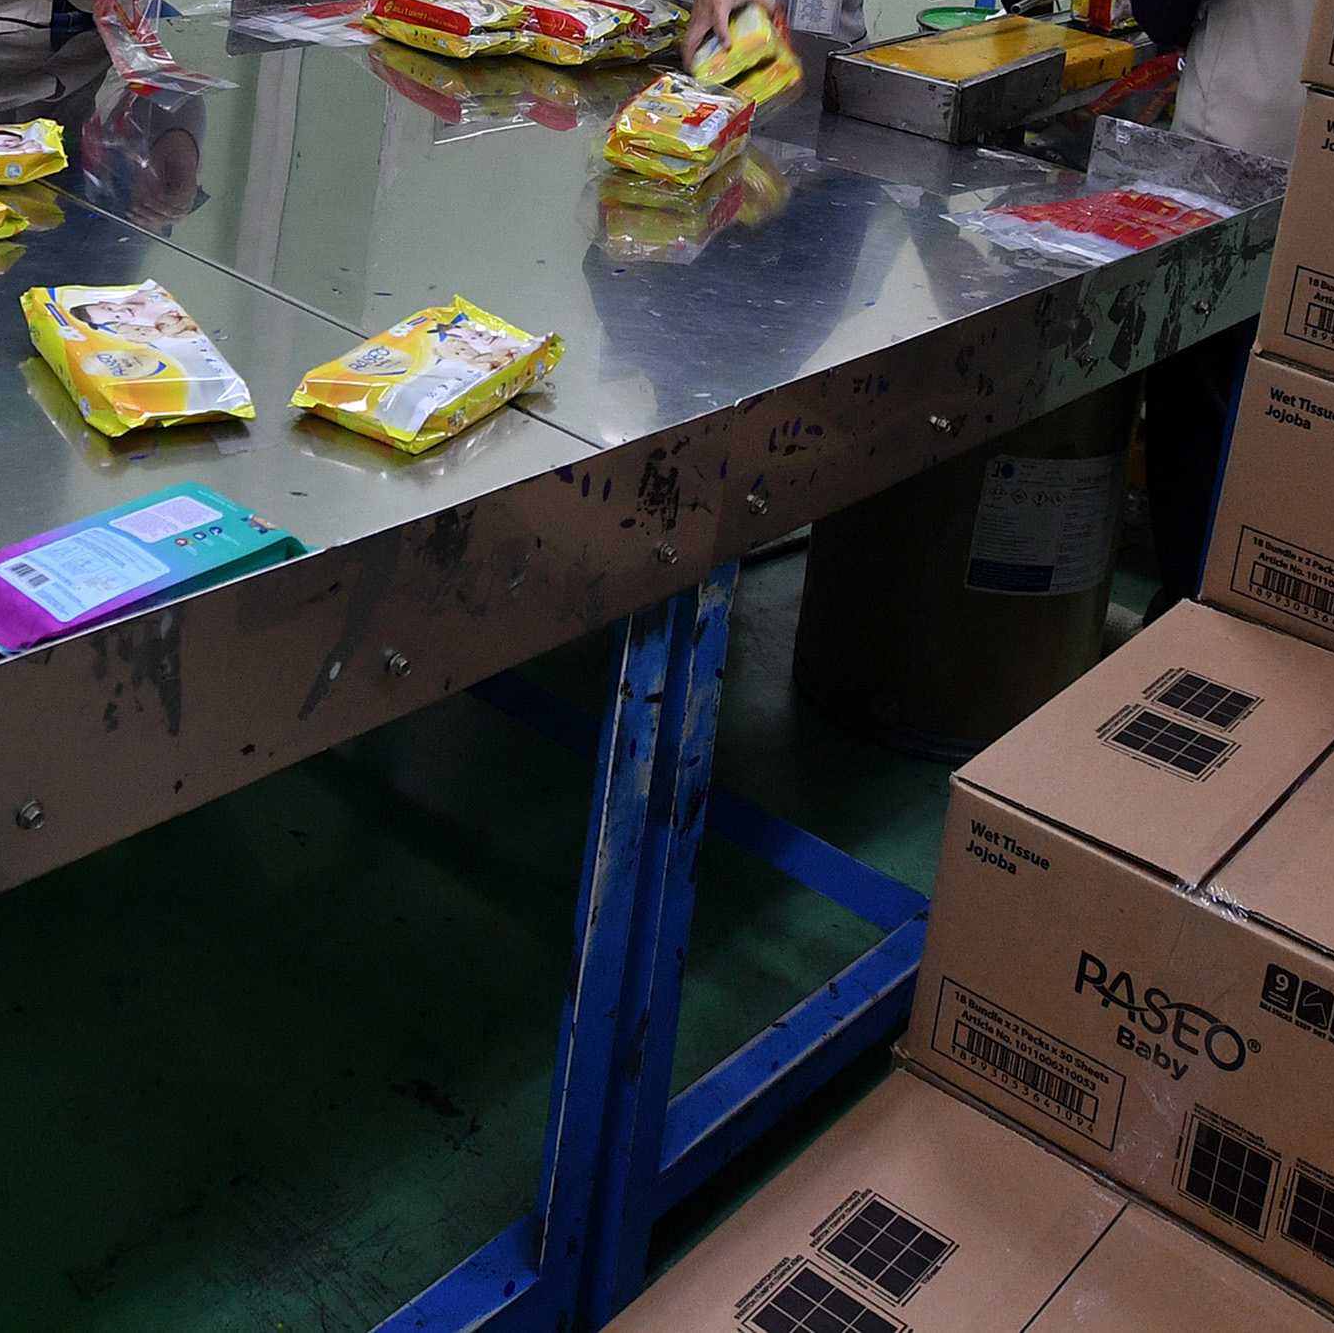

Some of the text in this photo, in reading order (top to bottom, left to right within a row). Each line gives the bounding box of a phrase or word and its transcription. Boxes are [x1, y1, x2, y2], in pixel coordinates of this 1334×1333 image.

[348, 345, 392, 372] PASEO
[1269, 386, 1297, 408] Wet
[1264, 403, 1312, 431] Jojoba
[964, 840, 1017, 877] Jojoba
[969, 820, 1050, 873] Wet Tissue
[1274, 973, 1289, 992] 9
[1115, 1024, 1190, 1081] Baby
